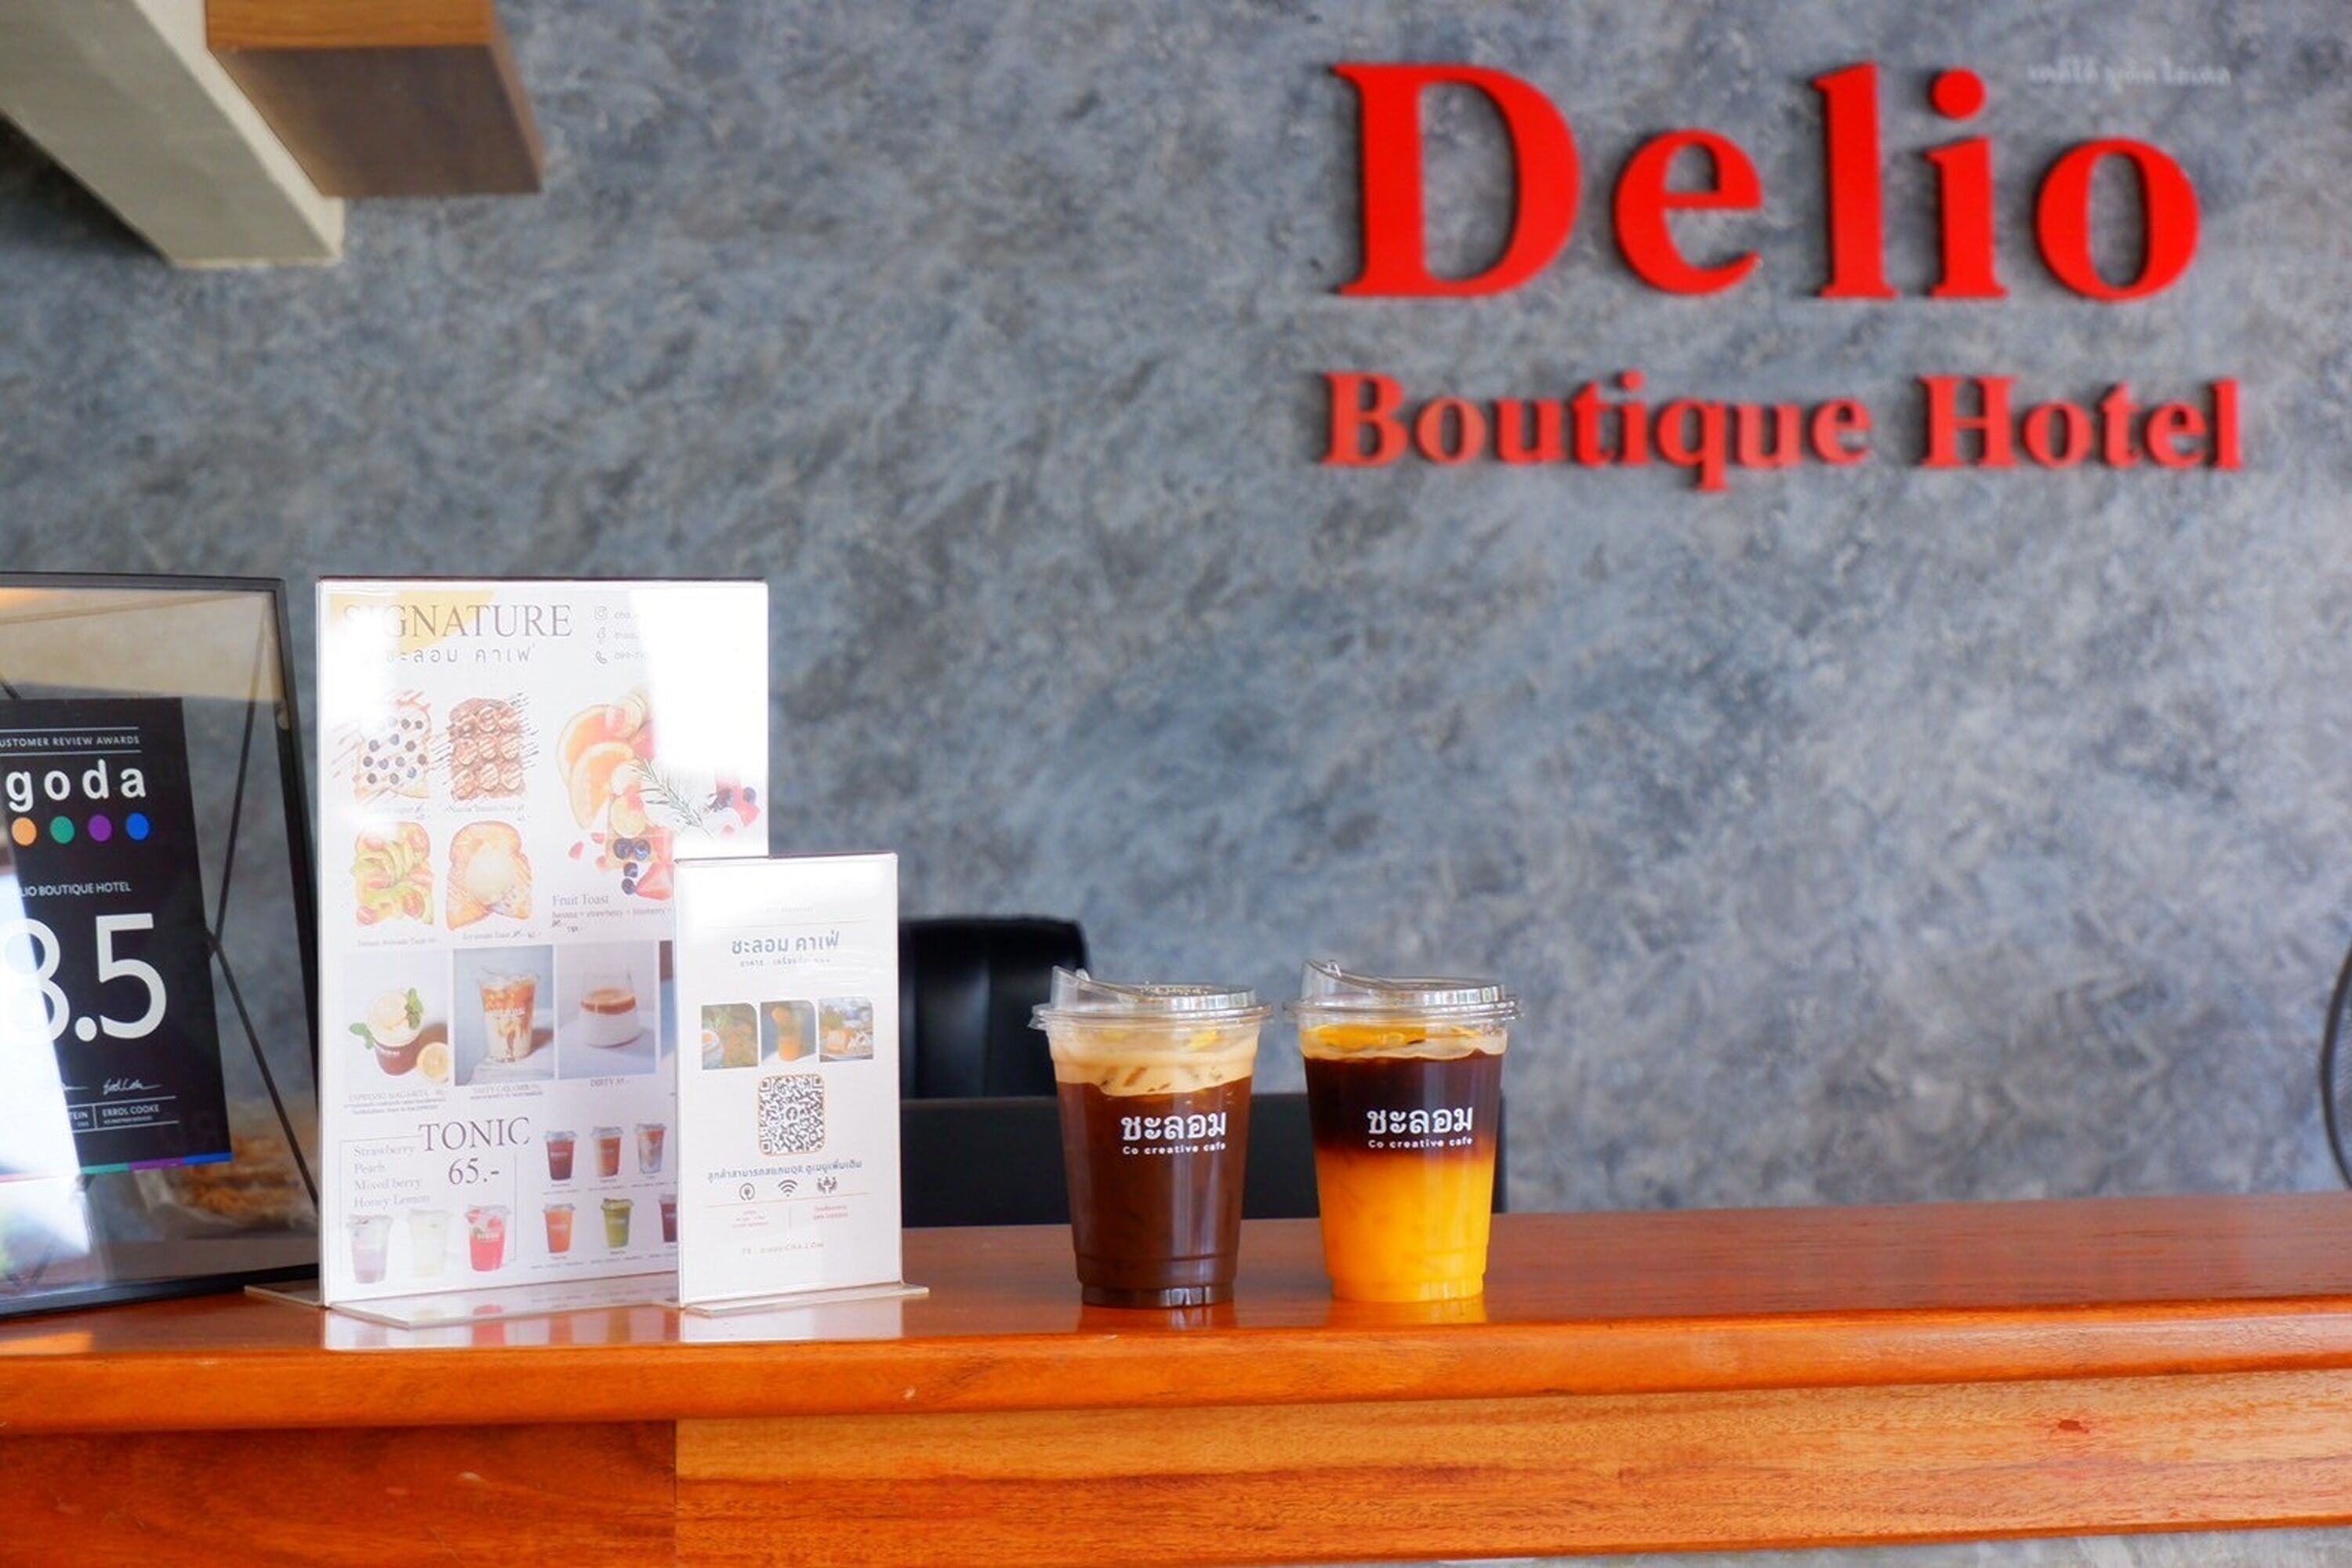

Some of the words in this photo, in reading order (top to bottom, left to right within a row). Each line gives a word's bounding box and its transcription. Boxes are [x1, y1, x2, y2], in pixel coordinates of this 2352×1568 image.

[1334, 63, 2201, 303] Delio
[1325, 372, 1871, 492] Boutique
[1925, 376, 2242, 470] Hotel
[343, 604, 572, 638] SGNATURE
[53, 736, 93, 746] REVIEW
[96, 735, 140, 746] AWARDS
[5, 758, 147, 813] goda
[38, 883, 94, 897] BOUTIQUE
[96, 881, 132, 893] HOTEL
[552, 895, 578, 906] Fruit
[583, 894, 609, 906] Toast
[731, 938, 789, 955] ชะลอม
[795, 930, 840, 951] คาเฟ่
[0, 912, 167, 1043] 8.5
[102, 1106, 129, 1118] ERROL
[129, 1103, 160, 1115] COOKE
[1367, 1106, 1474, 1135] ชะลอม
[418, 1116, 531, 1152] TONIC
[1120, 1111, 1228, 1142] ชะลอม
[353, 1143, 416, 1157] Strawberry
[1122, 1145, 1139, 1155] Co
[1144, 1145, 1200, 1155] creative
[1203, 1142, 1226, 1152] cafe
[1368, 1139, 1385, 1149] Co
[1388, 1138, 1445, 1149] creative
[1449, 1136, 1473, 1147] cafe
[353, 1163, 386, 1174] Peach
[448, 1156, 501, 1187] 65.-
[353, 1179, 390, 1192] Mixed
[391, 1177, 422, 1192] berry
[353, 1196, 390, 1210] Honey
[393, 1194, 431, 1207] Lemon
